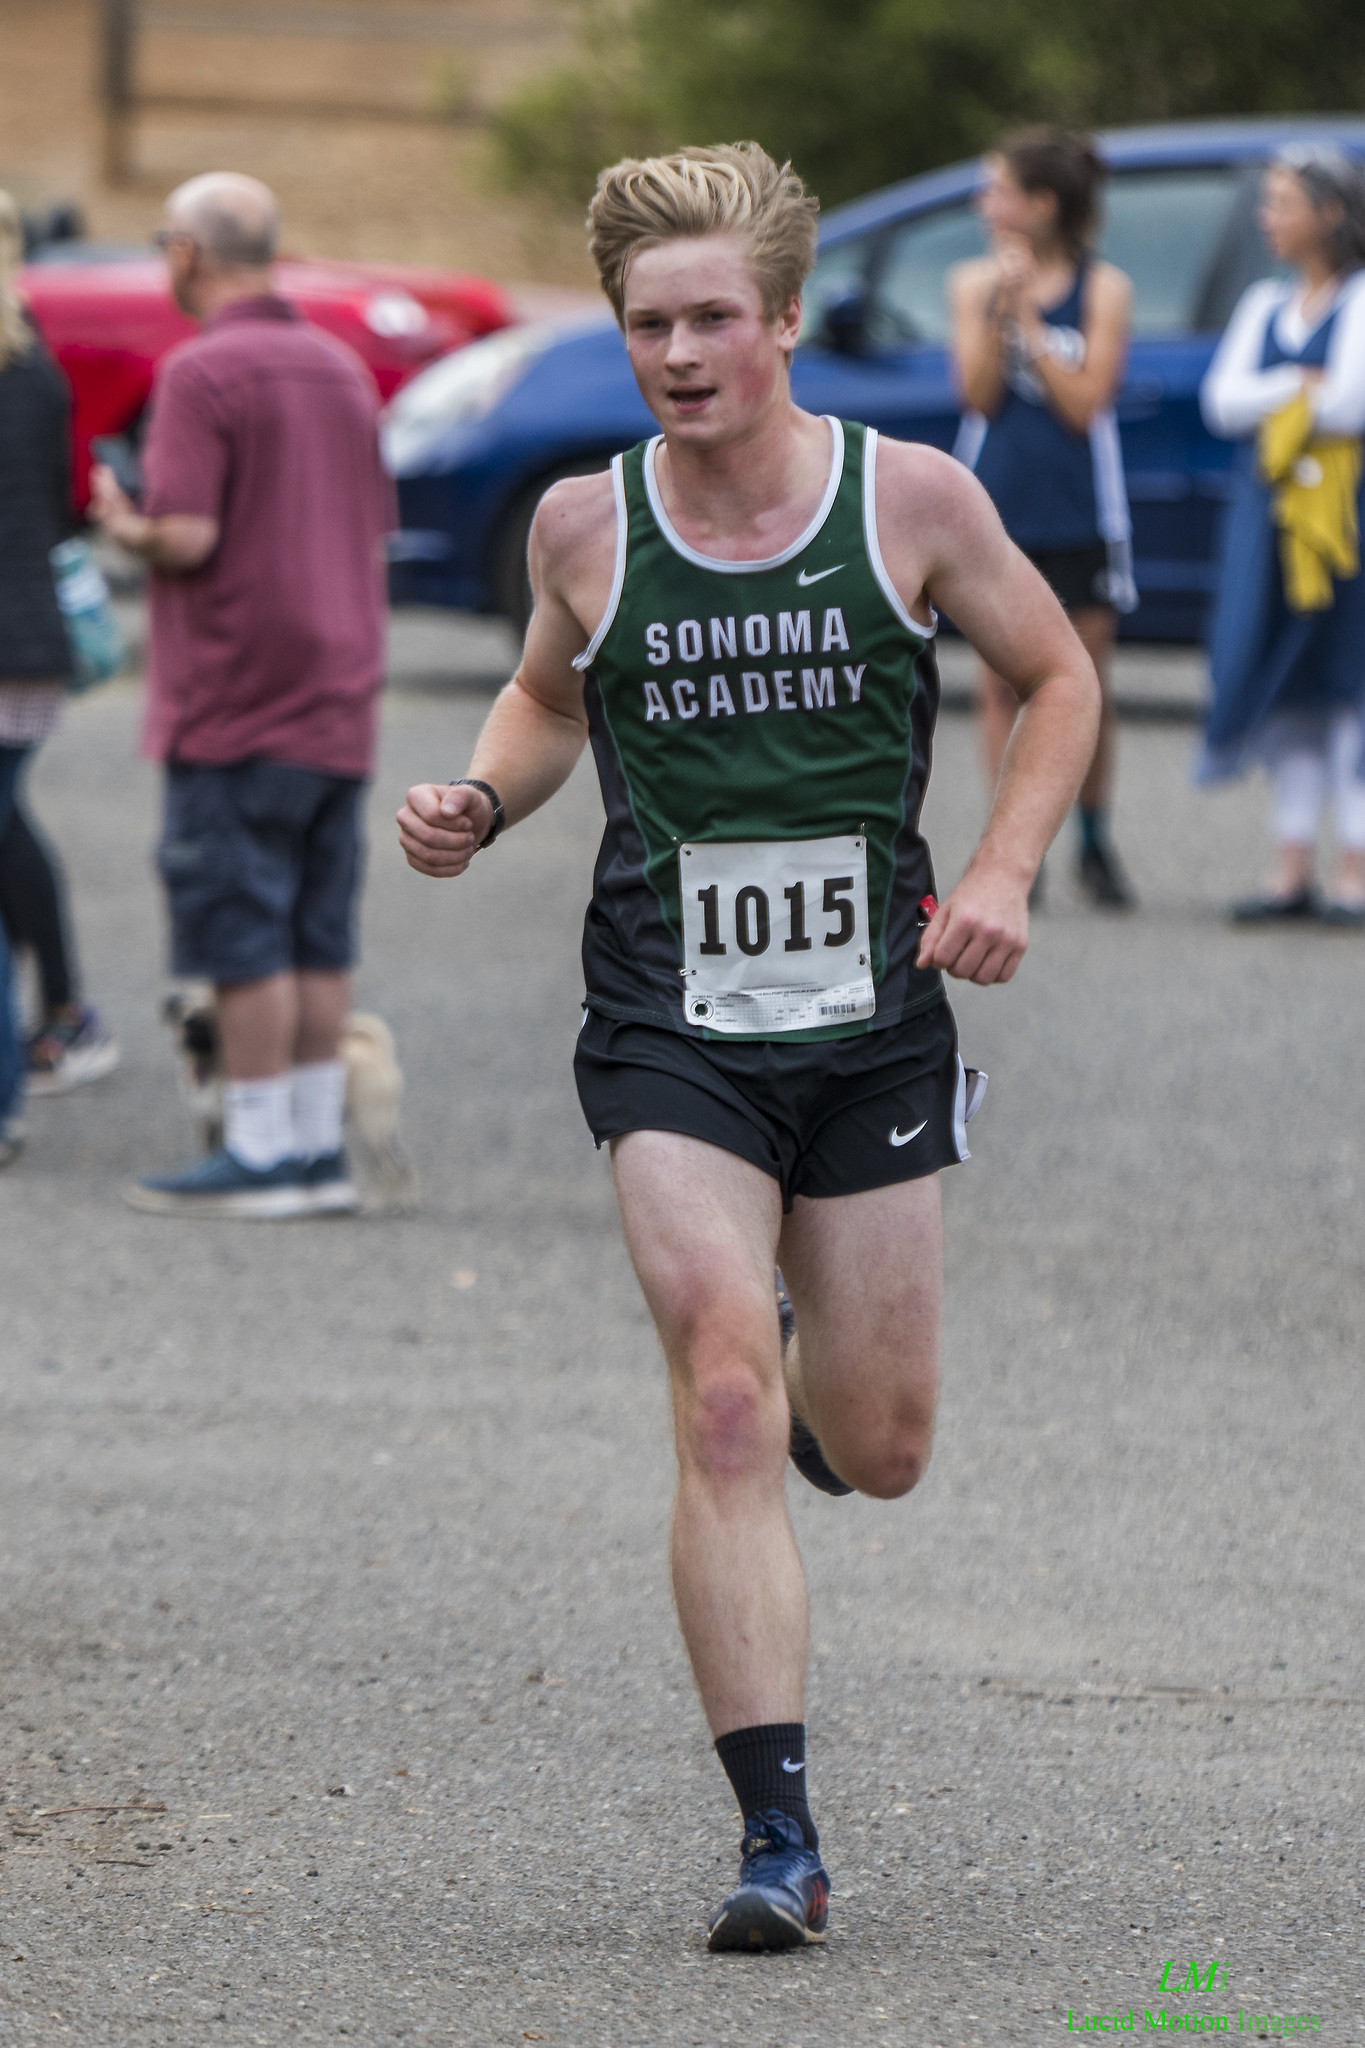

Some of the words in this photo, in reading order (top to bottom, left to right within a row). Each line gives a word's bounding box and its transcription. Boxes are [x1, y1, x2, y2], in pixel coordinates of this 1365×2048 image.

[645, 607, 850, 666] SONOMA
[643, 663, 867, 721] ACADEMY
[697, 876, 856, 956] 1015
